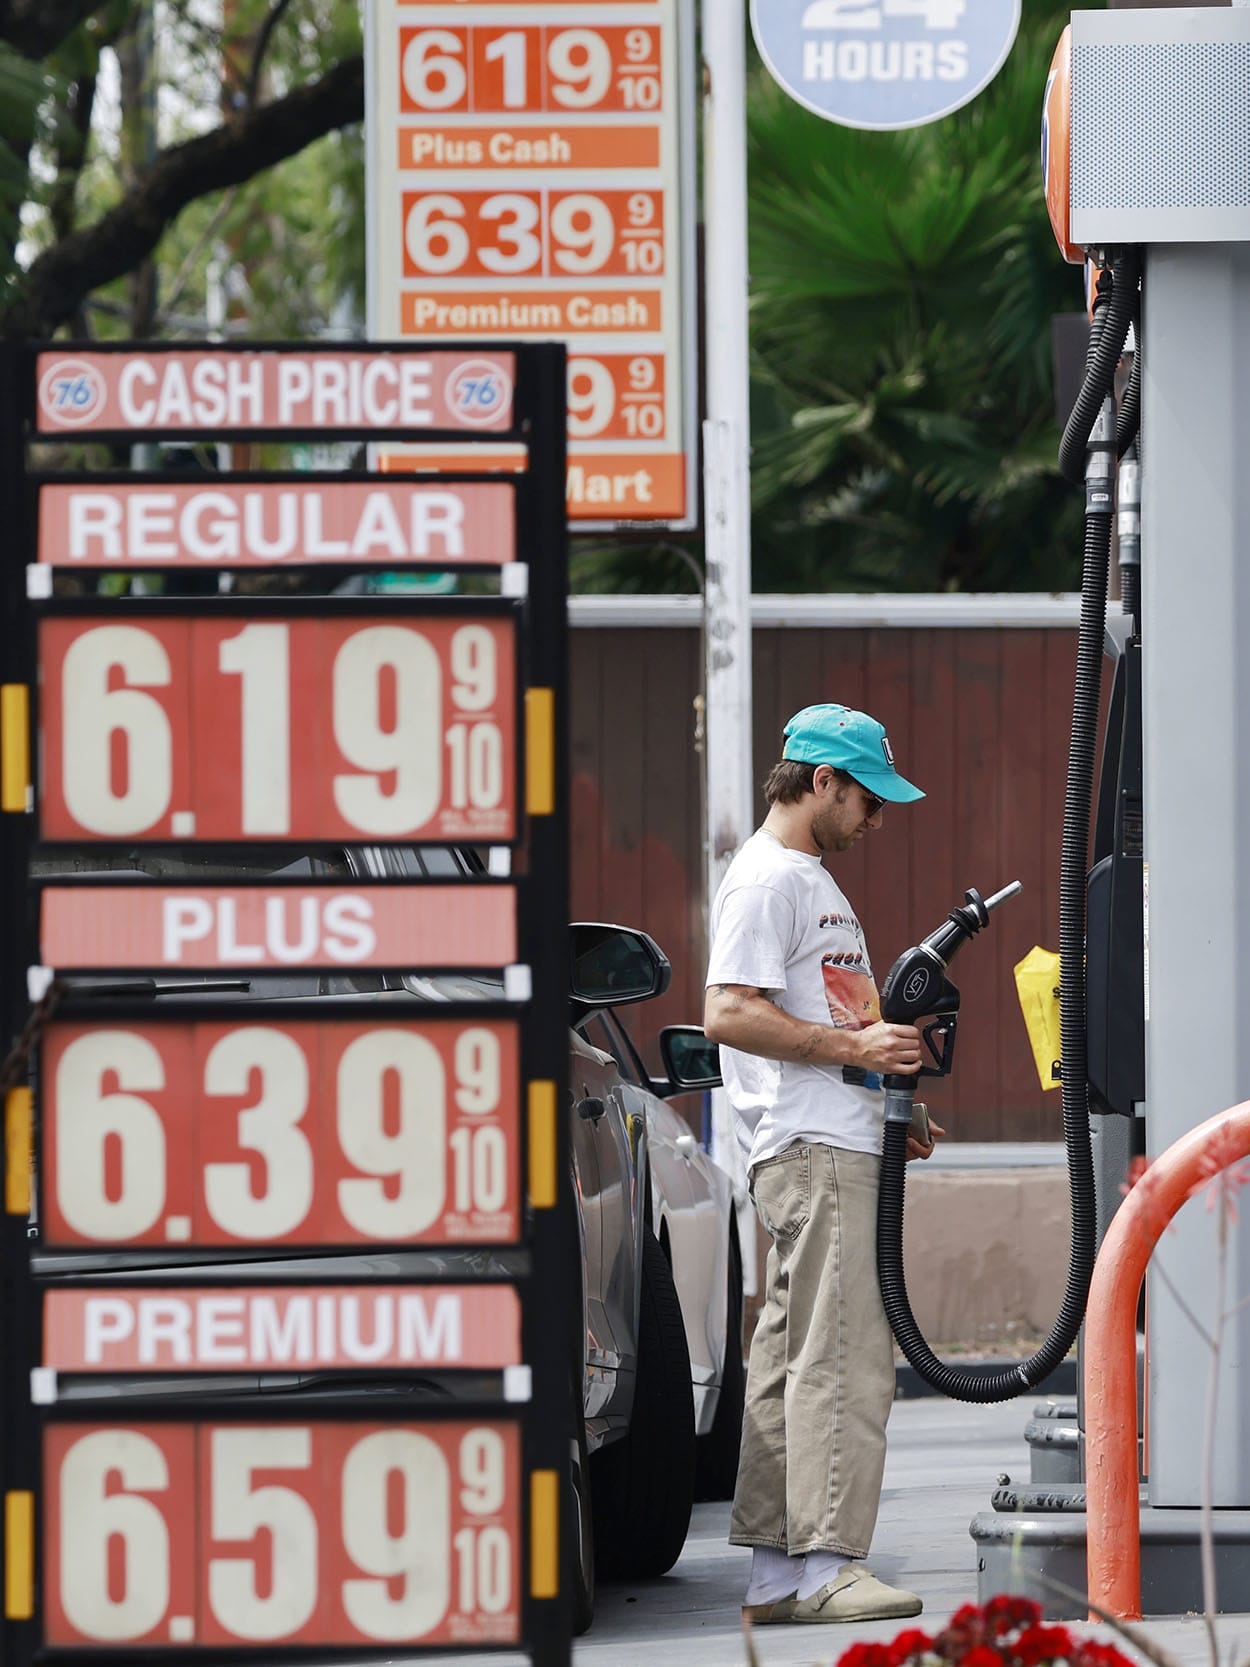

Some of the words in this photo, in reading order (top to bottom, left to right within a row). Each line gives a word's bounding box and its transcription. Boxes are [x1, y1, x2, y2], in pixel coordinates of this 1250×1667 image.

[402, 30, 612, 109] 619
[625, 30, 652, 61] 9
[803, 40, 968, 81] HOURS
[619, 77, 660, 107] 10
[412, 135, 483, 163] Plus
[490, 135, 570, 163] Cash
[405, 195, 615, 274] 639
[628, 195, 654, 226] 9
[622, 242, 663, 271] 10
[415, 299, 560, 328] Premium
[568, 299, 648, 327] Cash
[54, 382, 91, 408] 76
[118, 360, 262, 424] CASH
[280, 360, 433, 424] PRICE
[459, 381, 497, 407] 76
[629, 359, 656, 390] 9
[623, 406, 664, 436] 10
[69, 493, 465, 557] REGULAR
[450, 625, 496, 712] 9
[62, 624, 442, 836] 6.19
[446, 723, 502, 809] 10
[163, 895, 376, 962] PLUS
[455, 1027, 500, 1116] 9
[56, 1026, 445, 1240] 6.39
[450, 1126, 506, 1213] 10
[84, 1295, 463, 1362] PREMIUM
[460, 1428, 506, 1516] 9
[60, 1427, 450, 1641] 6.59
[454, 1527, 511, 1614] 10
